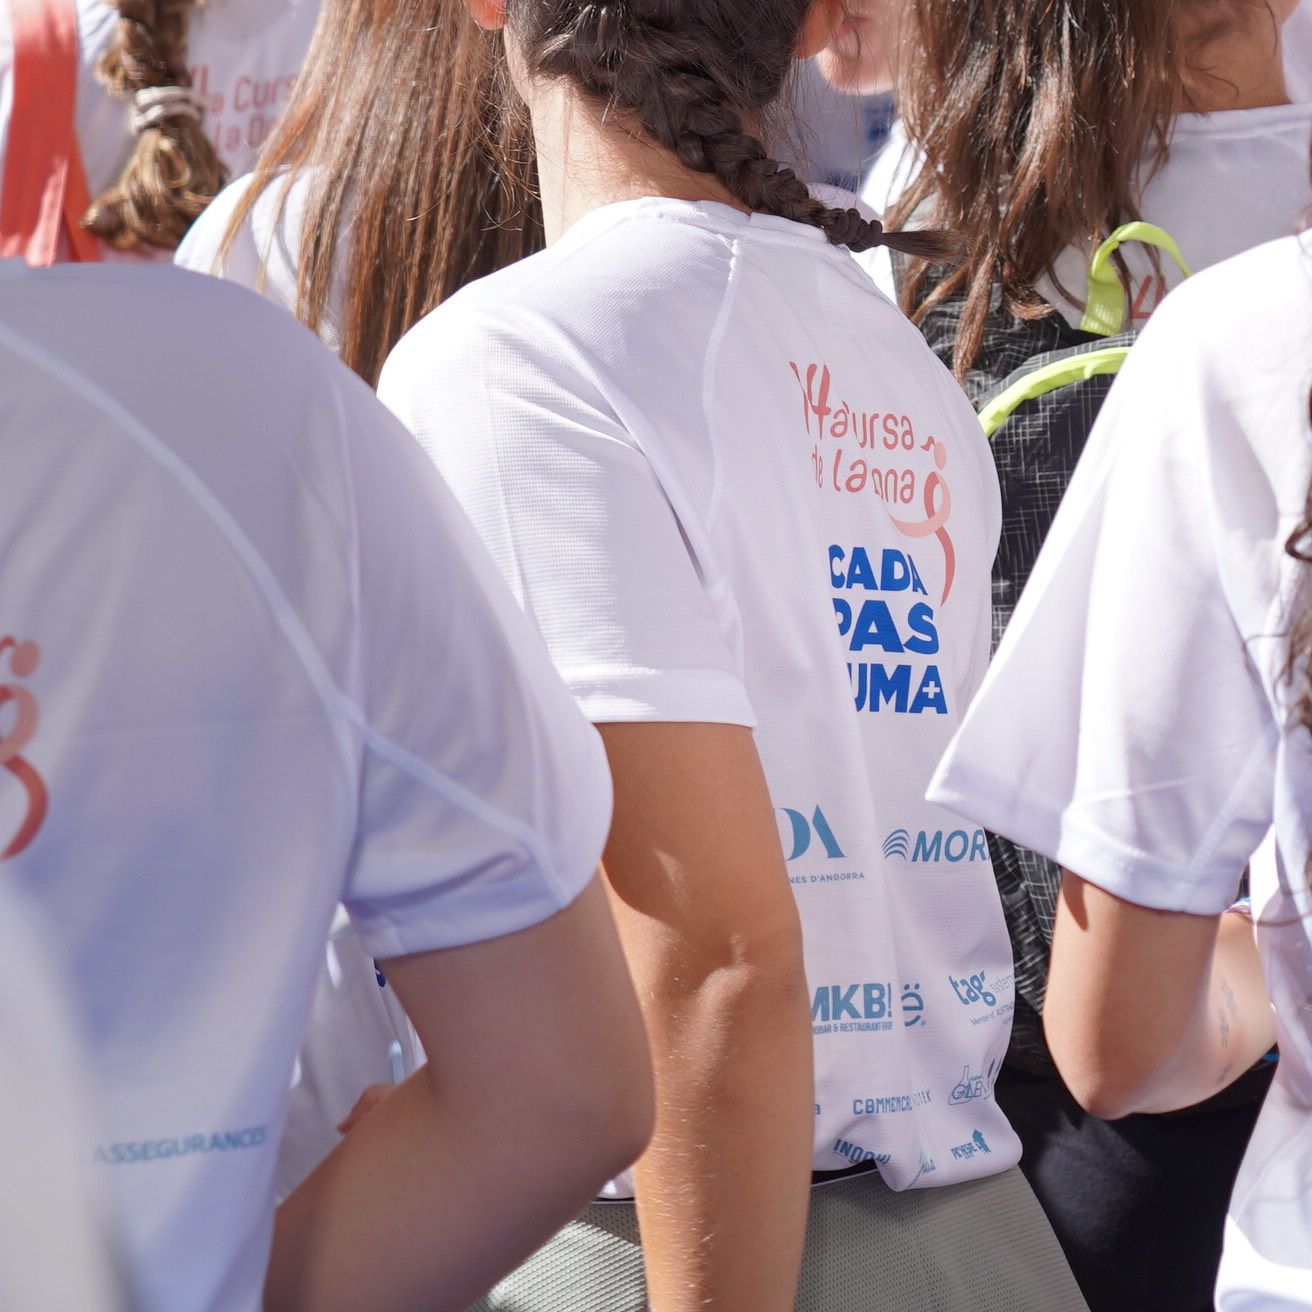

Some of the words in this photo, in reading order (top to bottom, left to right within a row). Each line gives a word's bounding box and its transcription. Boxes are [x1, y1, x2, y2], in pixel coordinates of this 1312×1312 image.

[833, 448, 867, 492] la
[828, 544, 928, 596] CADA
[846, 662, 948, 714] UMA
[911, 829, 990, 863] MOR
[811, 872, 865, 883] D'ANDORRA
